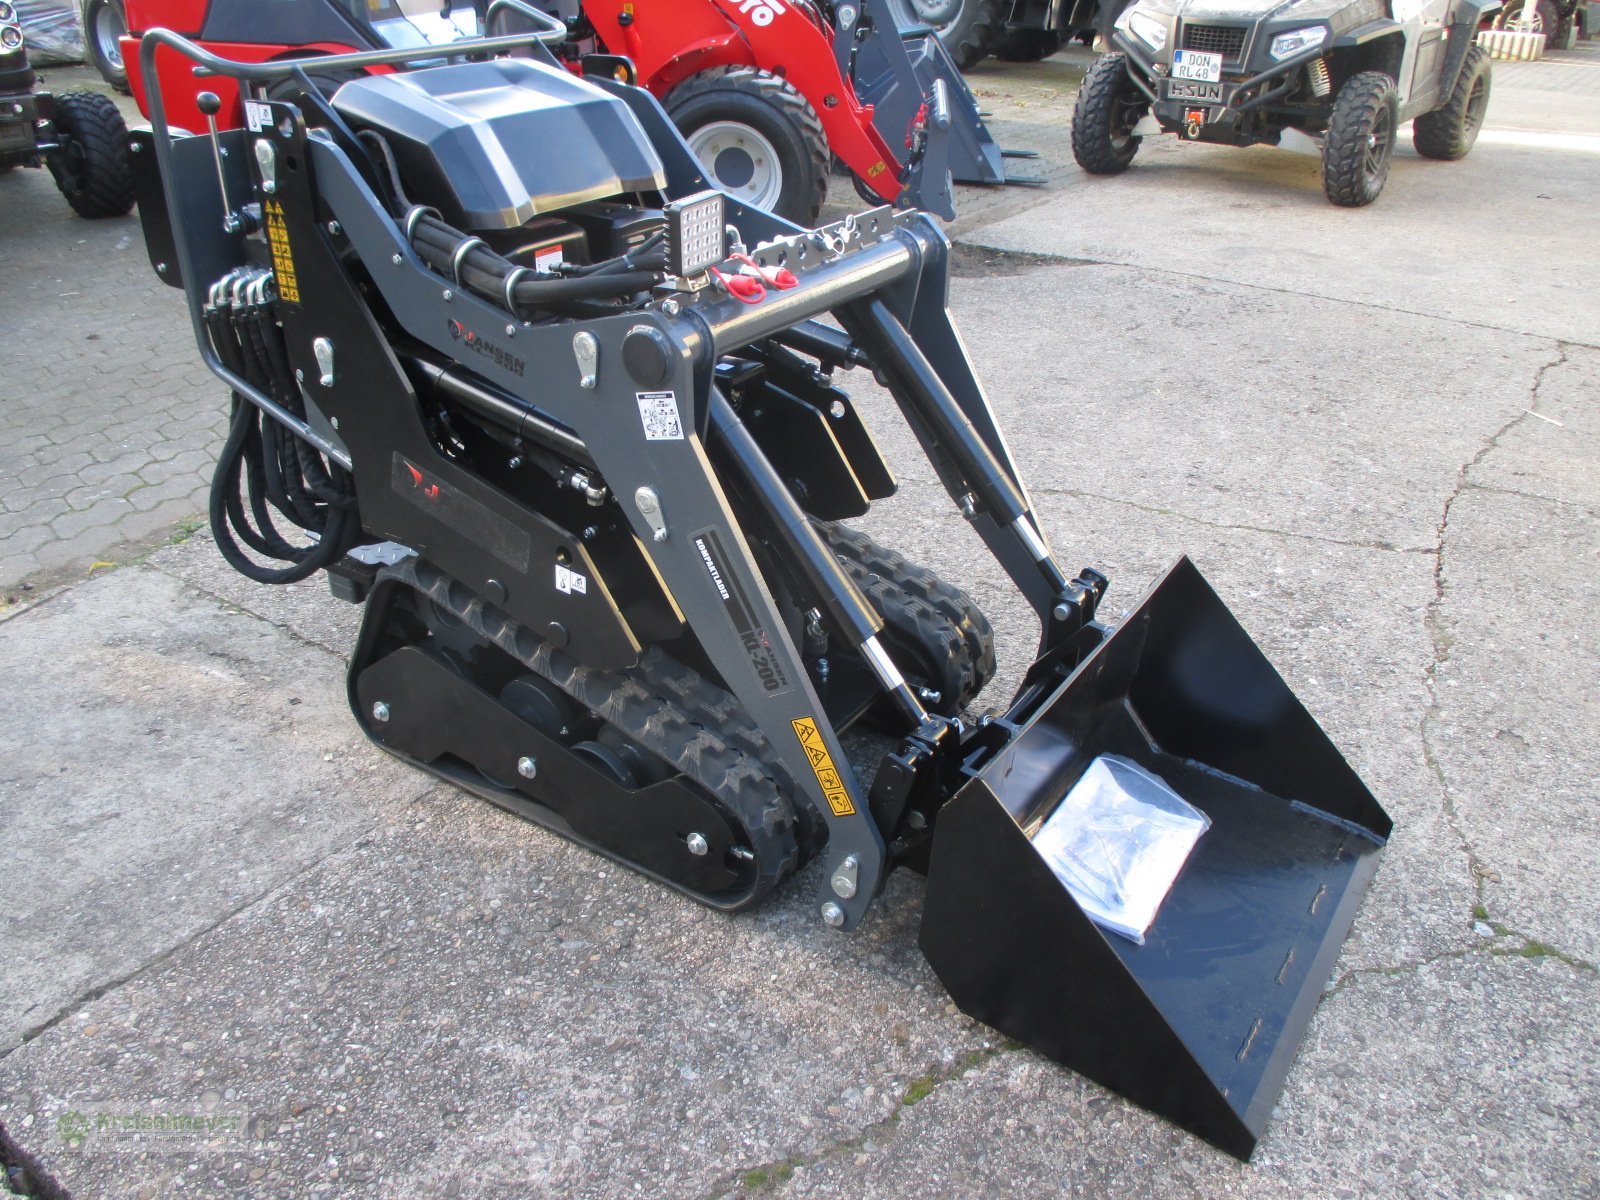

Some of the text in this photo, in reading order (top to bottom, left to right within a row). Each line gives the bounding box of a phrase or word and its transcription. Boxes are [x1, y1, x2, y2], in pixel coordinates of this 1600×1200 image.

[1179, 66, 1209, 79] RL 48
[1189, 54, 1211, 66] DON
[464, 330, 526, 372] JANSEN
[695, 538, 730, 600] KOMPAKTLADER
[740, 631, 780, 691] KL-200
[760, 637, 789, 686] JANSEN
